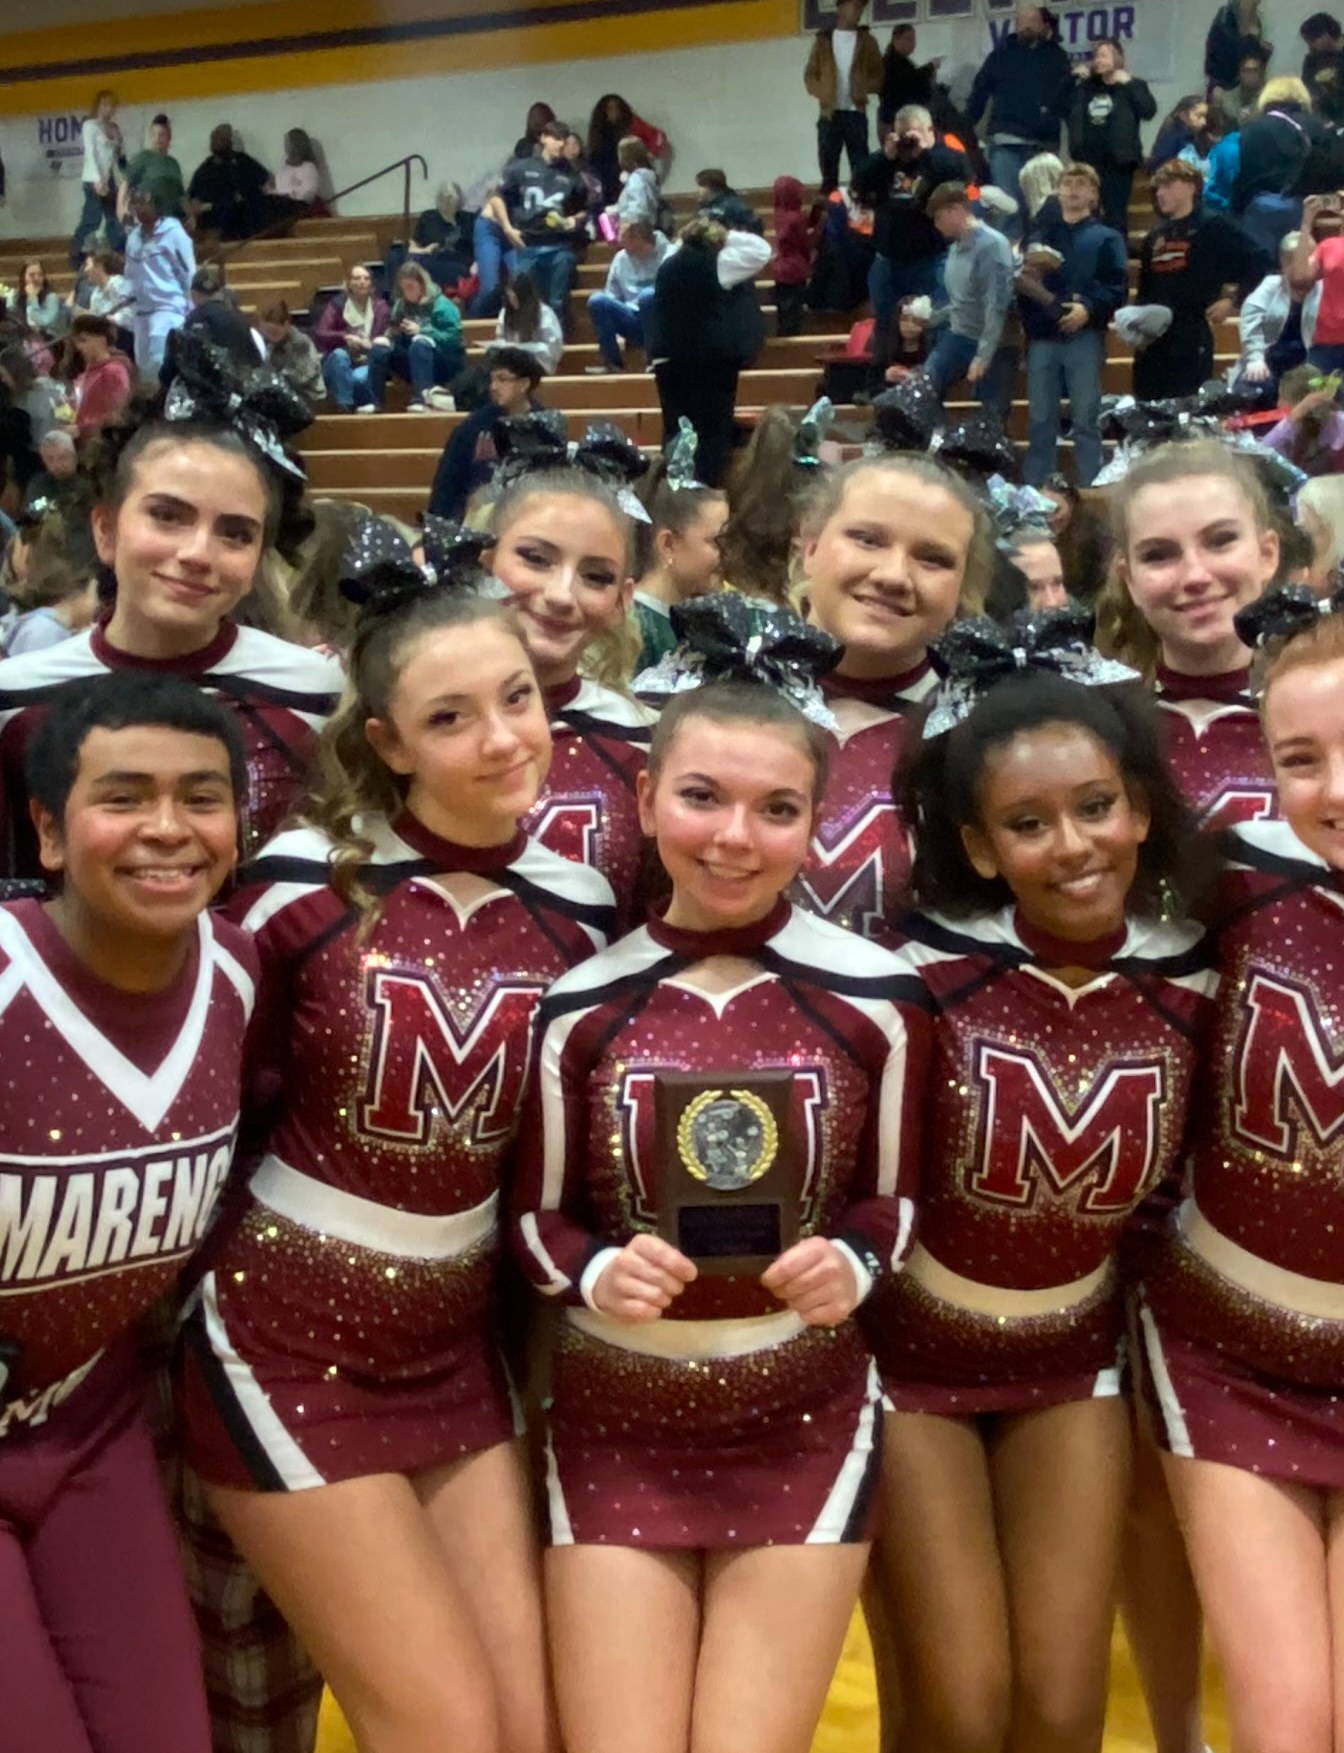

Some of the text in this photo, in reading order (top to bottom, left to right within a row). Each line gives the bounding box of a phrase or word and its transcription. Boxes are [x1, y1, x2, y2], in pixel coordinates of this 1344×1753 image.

[989, 6, 1135, 51] VTOR
[38, 115, 83, 143] HOM
[360, 966, 550, 1145] M
[968, 1037, 1169, 1213] M
